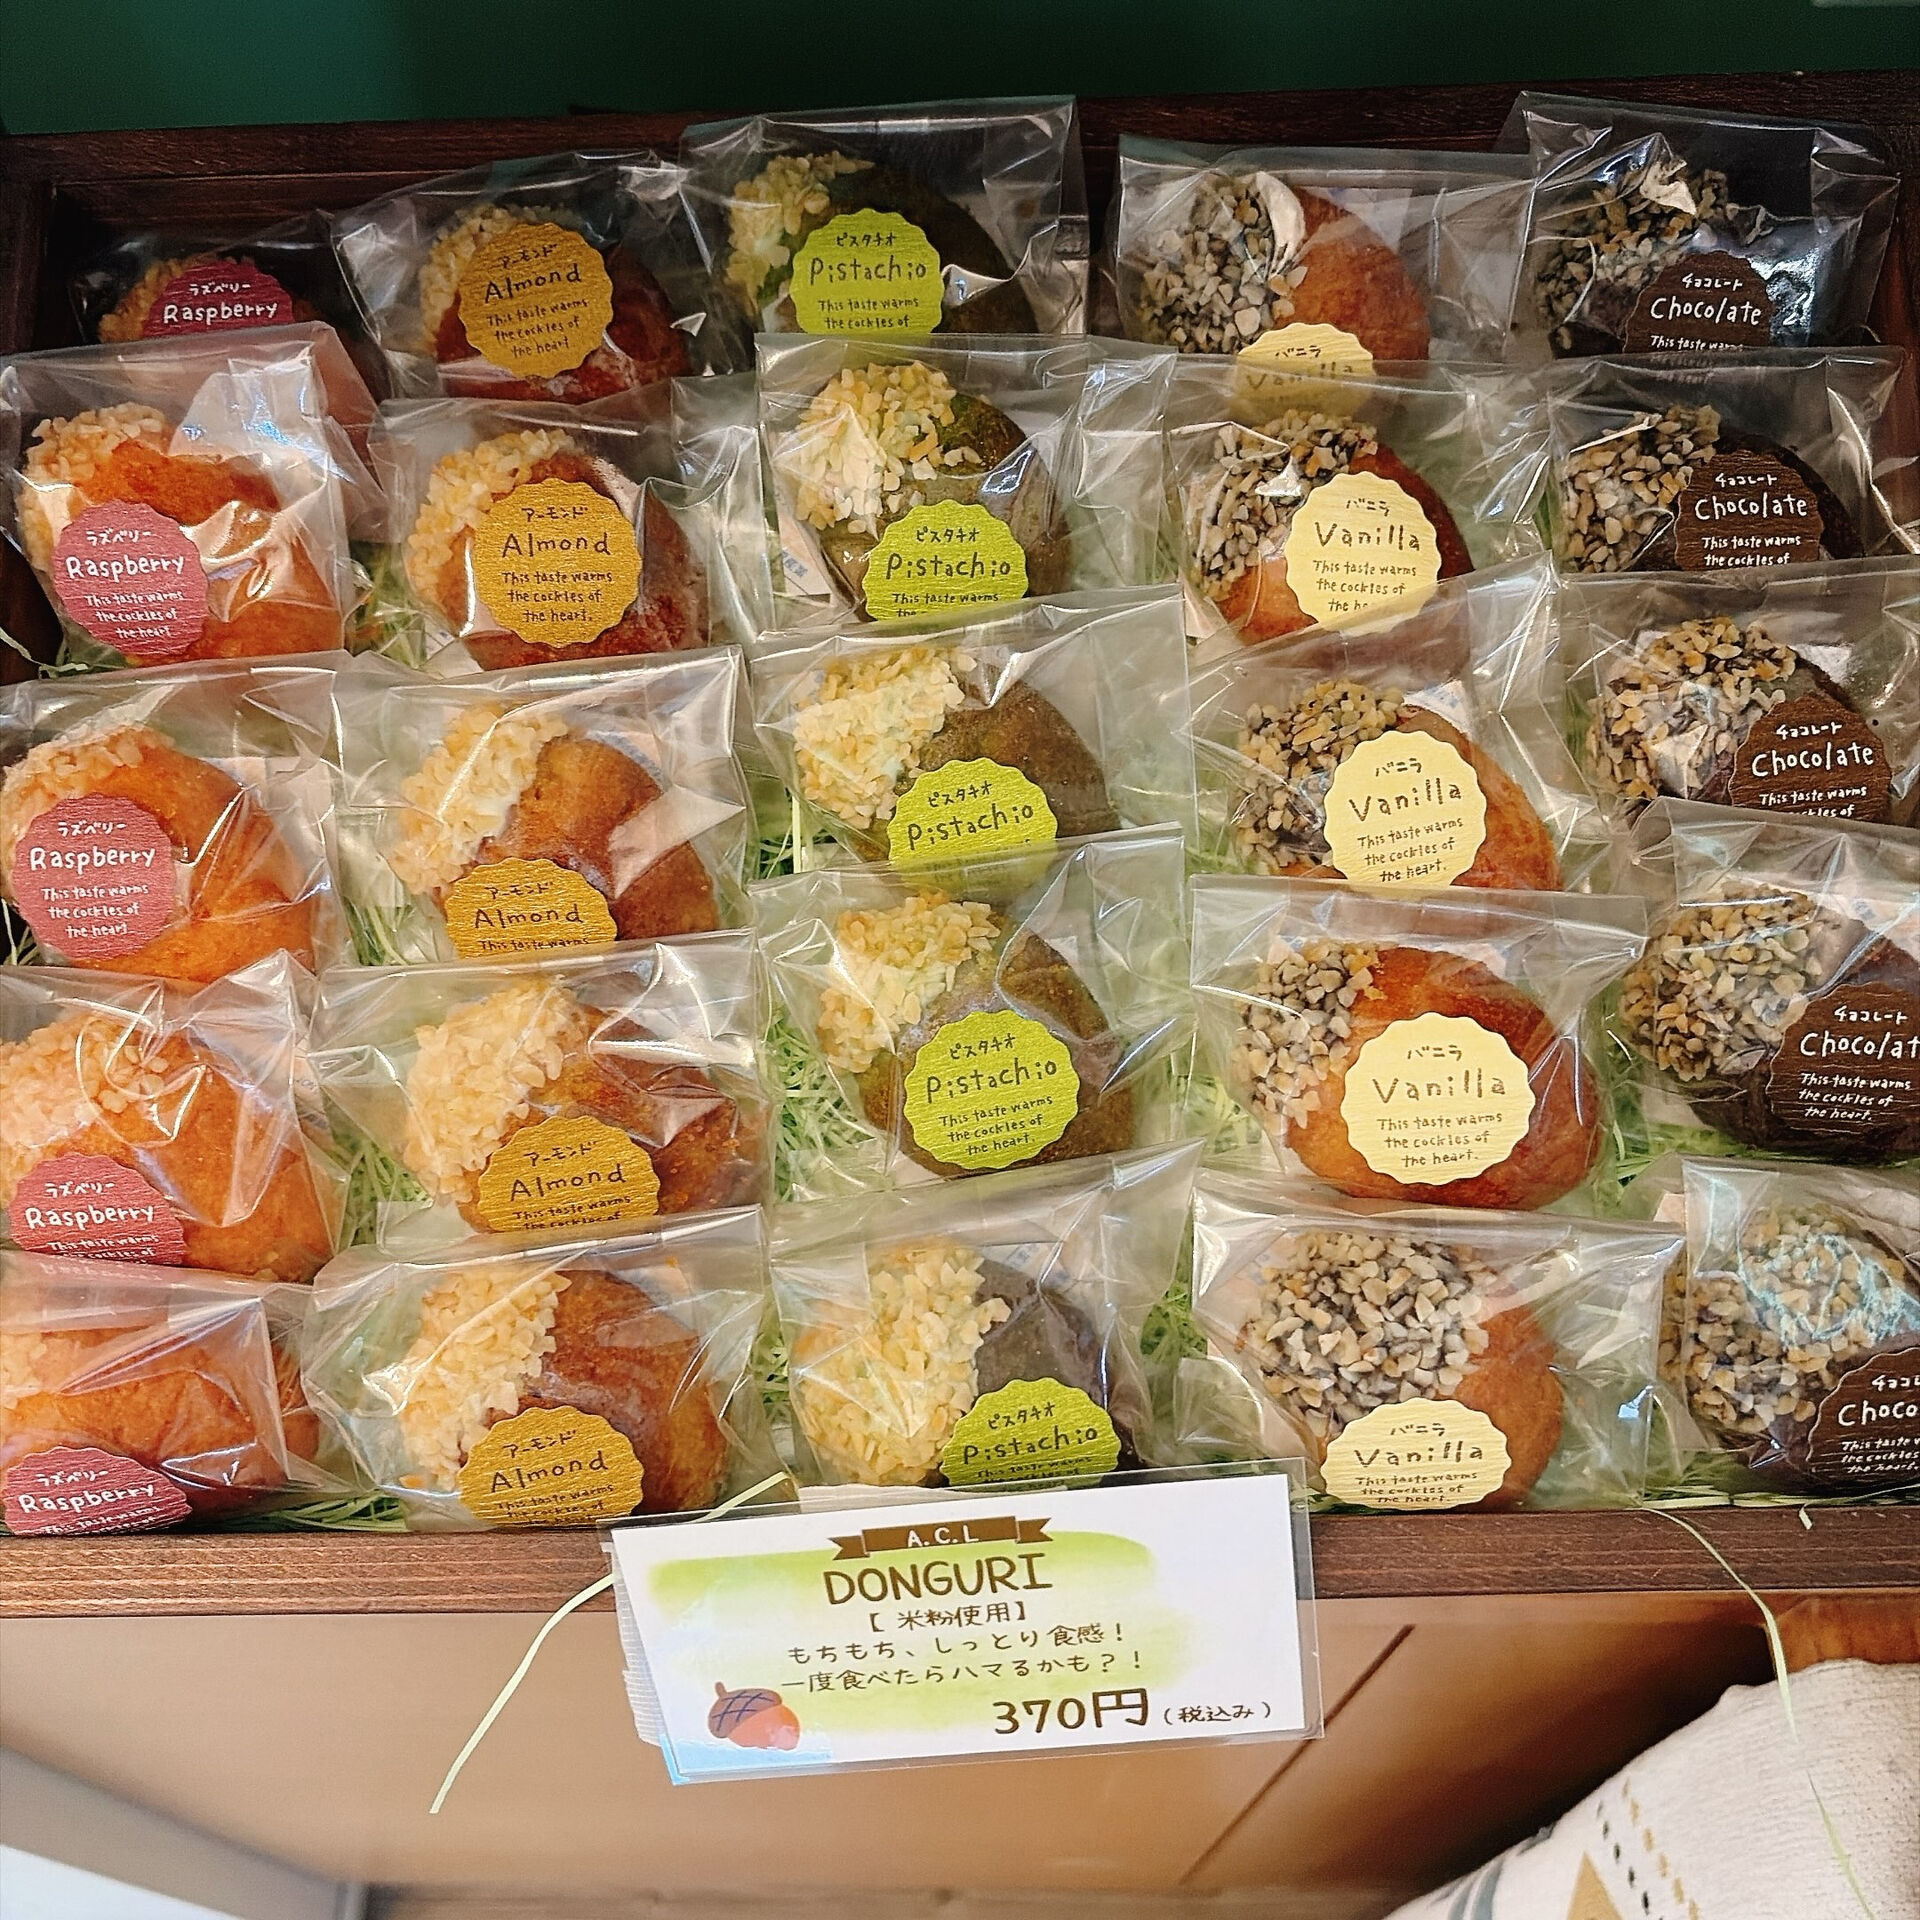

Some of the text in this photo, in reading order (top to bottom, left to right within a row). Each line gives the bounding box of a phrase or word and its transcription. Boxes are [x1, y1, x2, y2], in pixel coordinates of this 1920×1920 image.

[836, 232, 896, 246] ピスタチオ
[499, 244, 557, 268] アーモンド
[811, 255, 926, 285] Pistachio
[189, 283, 251, 295] ラズベリー
[485, 263, 581, 303] Almond
[1682, 273, 1742, 291] チョコレート
[164, 302, 277, 325] Raspberry
[818, 298, 919, 313] This taste warms
[1651, 296, 1761, 325] Chocolate
[495, 316, 579, 341] the of
[825, 315, 909, 329] the of
[512, 345, 531, 358] the
[1275, 345, 1321, 359] バニラ
[1650, 336, 1706, 350] This taste
[1715, 473, 1777, 487] チョコレート
[521, 507, 588, 522] アーモンド
[1346, 498, 1389, 516] バニラ
[1695, 492, 1807, 520] Chocolate
[86, 528, 151, 546] ラズベリー
[917, 526, 979, 542] ピスタチオ
[1315, 522, 1420, 551] Vanilla
[1702, 535, 1800, 550] This taste warms
[502, 532, 611, 558] Almond
[66, 555, 183, 582] Raspberry
[886, 552, 1010, 580] Pistachio
[1313, 560, 1417, 576] This taste warms
[1704, 552, 1790, 567] the cockles of
[502, 571, 612, 584] This taste warms
[1316, 578, 1405, 595] the cockles of
[84, 592, 183, 607] This taste warms
[508, 590, 602, 602] the cockles of
[892, 593, 999, 604] This taste warms
[95, 608, 177, 622] the of
[1328, 600, 1348, 612] the
[523, 609, 592, 622] the heart.
[1776, 722, 1842, 740] チョコレート
[1375, 758, 1422, 776] バニラ
[1752, 742, 1873, 777] Chocolate
[928, 781, 992, 807] ピスタチオ
[1349, 778, 1461, 821] Vanilla
[1759, 787, 1867, 806] This taste warms
[1840, 804, 1854, 816] of
[57, 820, 126, 836] ラズベリー
[907, 803, 1033, 850] Pistachio
[1357, 818, 1464, 849] This taste warms
[30, 846, 155, 875] Raspberry
[1364, 837, 1455, 866] the cockles of
[1379, 859, 1446, 882] the heart.
[41, 885, 149, 901] This taste warms
[485, 883, 553, 899] アーモンド
[48, 902, 139, 919] the of
[475, 903, 583, 928] Almond
[66, 926, 87, 938] the
[478, 938, 589, 951] This taste warms
[1834, 1006, 1908, 1024] チョコレート
[950, 1033, 1016, 1059] ピスタチオ
[1407, 1045, 1462, 1061] バニラ
[1801, 1030, 1920, 1060] Chocolat
[927, 1058, 1057, 1103] Pistachio
[1373, 1067, 1505, 1103] Vanilla
[1801, 1073, 1912, 1090] This taste warms
[1799, 1089, 1894, 1106] the cockles of
[939, 1096, 1052, 1127] This taste warms
[1805, 1107, 1872, 1121] the heart.
[948, 1114, 1043, 1142] the cockles of
[1376, 1113, 1502, 1130] This taste warms
[966, 1133, 1035, 1155] the heart.
[1385, 1131, 1490, 1148] the cockles of
[523, 1141, 598, 1166] アーモンド
[1401, 1149, 1478, 1167] the heart.
[44, 1181, 114, 1198] ラズベリー
[511, 1163, 626, 1201] Almond
[512, 1196, 630, 1219] This taste warms
[25, 1205, 153, 1230] Raspberry
[988, 1402, 1056, 1429] ピスタチオ
[1838, 1400, 1918, 1426] Choco
[1390, 1423, 1445, 1436] バニラ
[503, 1430, 576, 1458] アーモンド
[964, 1425, 1097, 1464] Pistachio
[1842, 1441, 1870, 1451] This
[1354, 1441, 1482, 1467] Vanilla
[35, 1470, 108, 1487] ラズベリー
[491, 1451, 608, 1493] Almond
[1355, 1473, 1477, 1486] This taste warms
[1449, 1484, 1464, 1492] of
[18, 1485, 154, 1513] Raspberry
[907, 1525, 979, 1547] A.C.L
[823, 1552, 1053, 1605] DONGURI
[788, 1622, 1123, 1664] もちもち、しっとり食感！
[993, 1688, 1148, 1734] 370円
